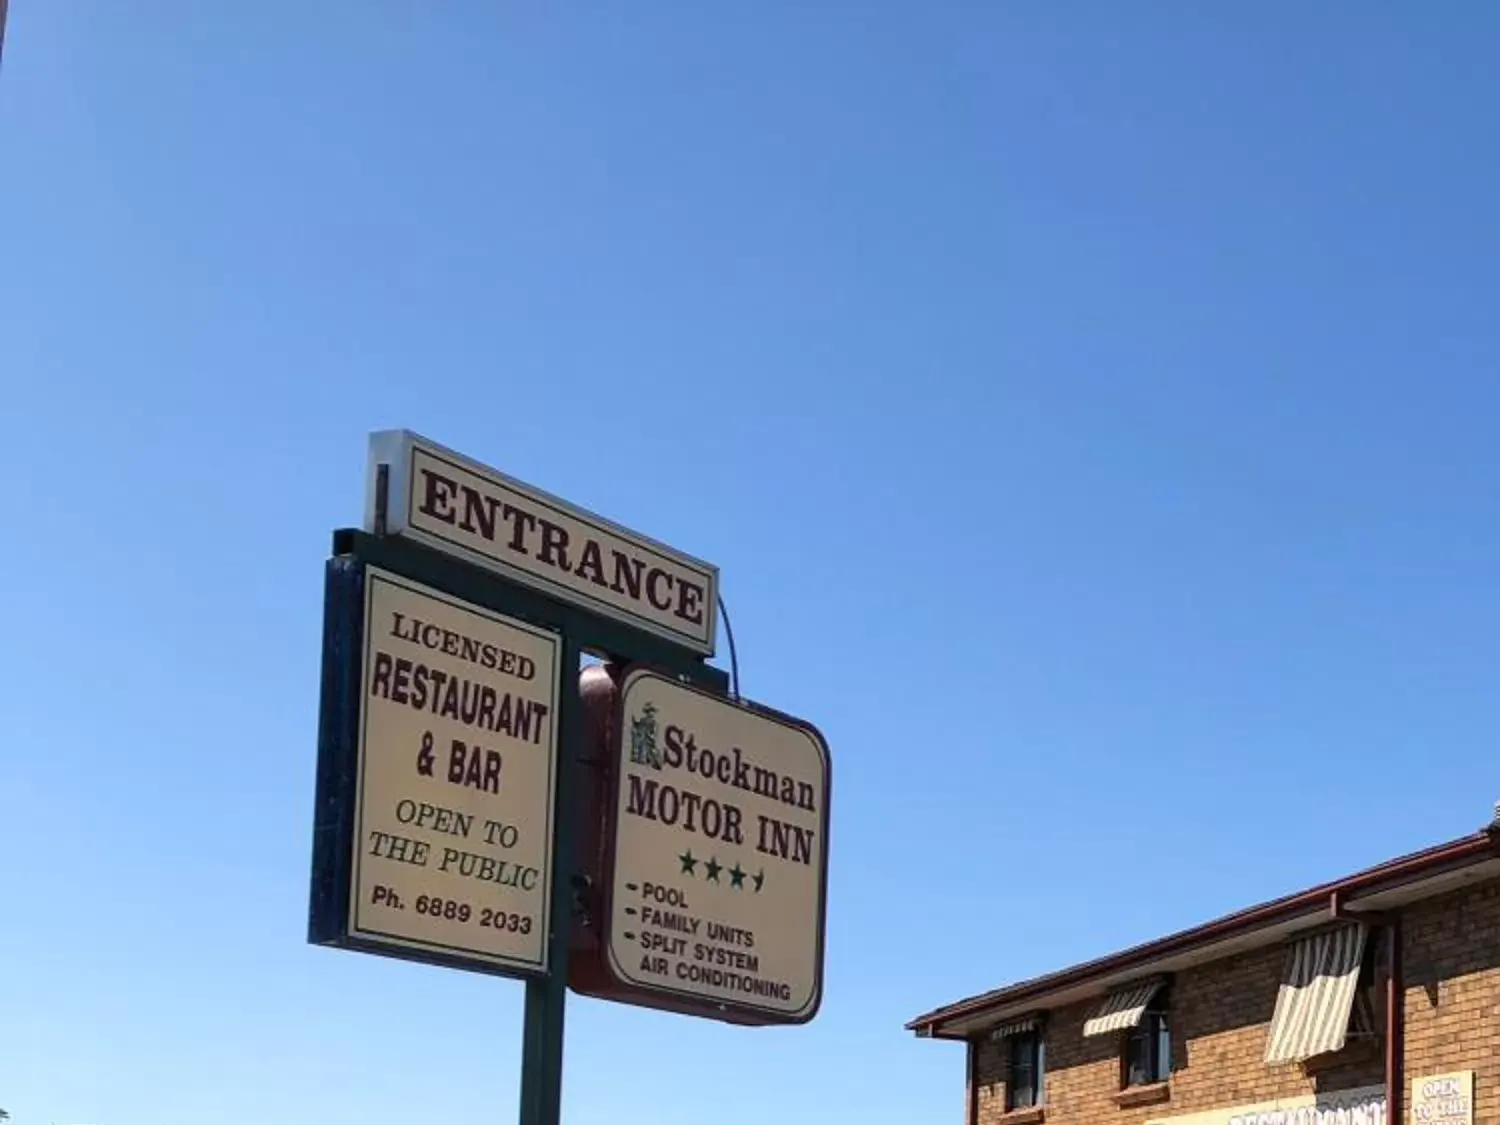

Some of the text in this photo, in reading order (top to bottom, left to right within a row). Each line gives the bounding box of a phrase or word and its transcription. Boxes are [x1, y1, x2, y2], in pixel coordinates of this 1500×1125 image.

[417, 467, 706, 627] ENTRANCE
[389, 611, 536, 682] LICENSED
[371, 650, 548, 745] RESTAURANT
[416, 730, 502, 795] & BAR
[664, 724, 815, 812] Stockman
[396, 799, 519, 848] OPEN TO
[626, 773, 815, 865] MOTOR INN
[368, 831, 540, 891] THE PUBLIC
[371, 885, 532, 935] Ph. 6889 2033
[642, 882, 689, 908] POOL
[640, 906, 754, 948] FAMILY UNITS
[640, 931, 759, 972] SPLIT SYSTEM
[639, 955, 791, 1001] AIR CONDITIONING
